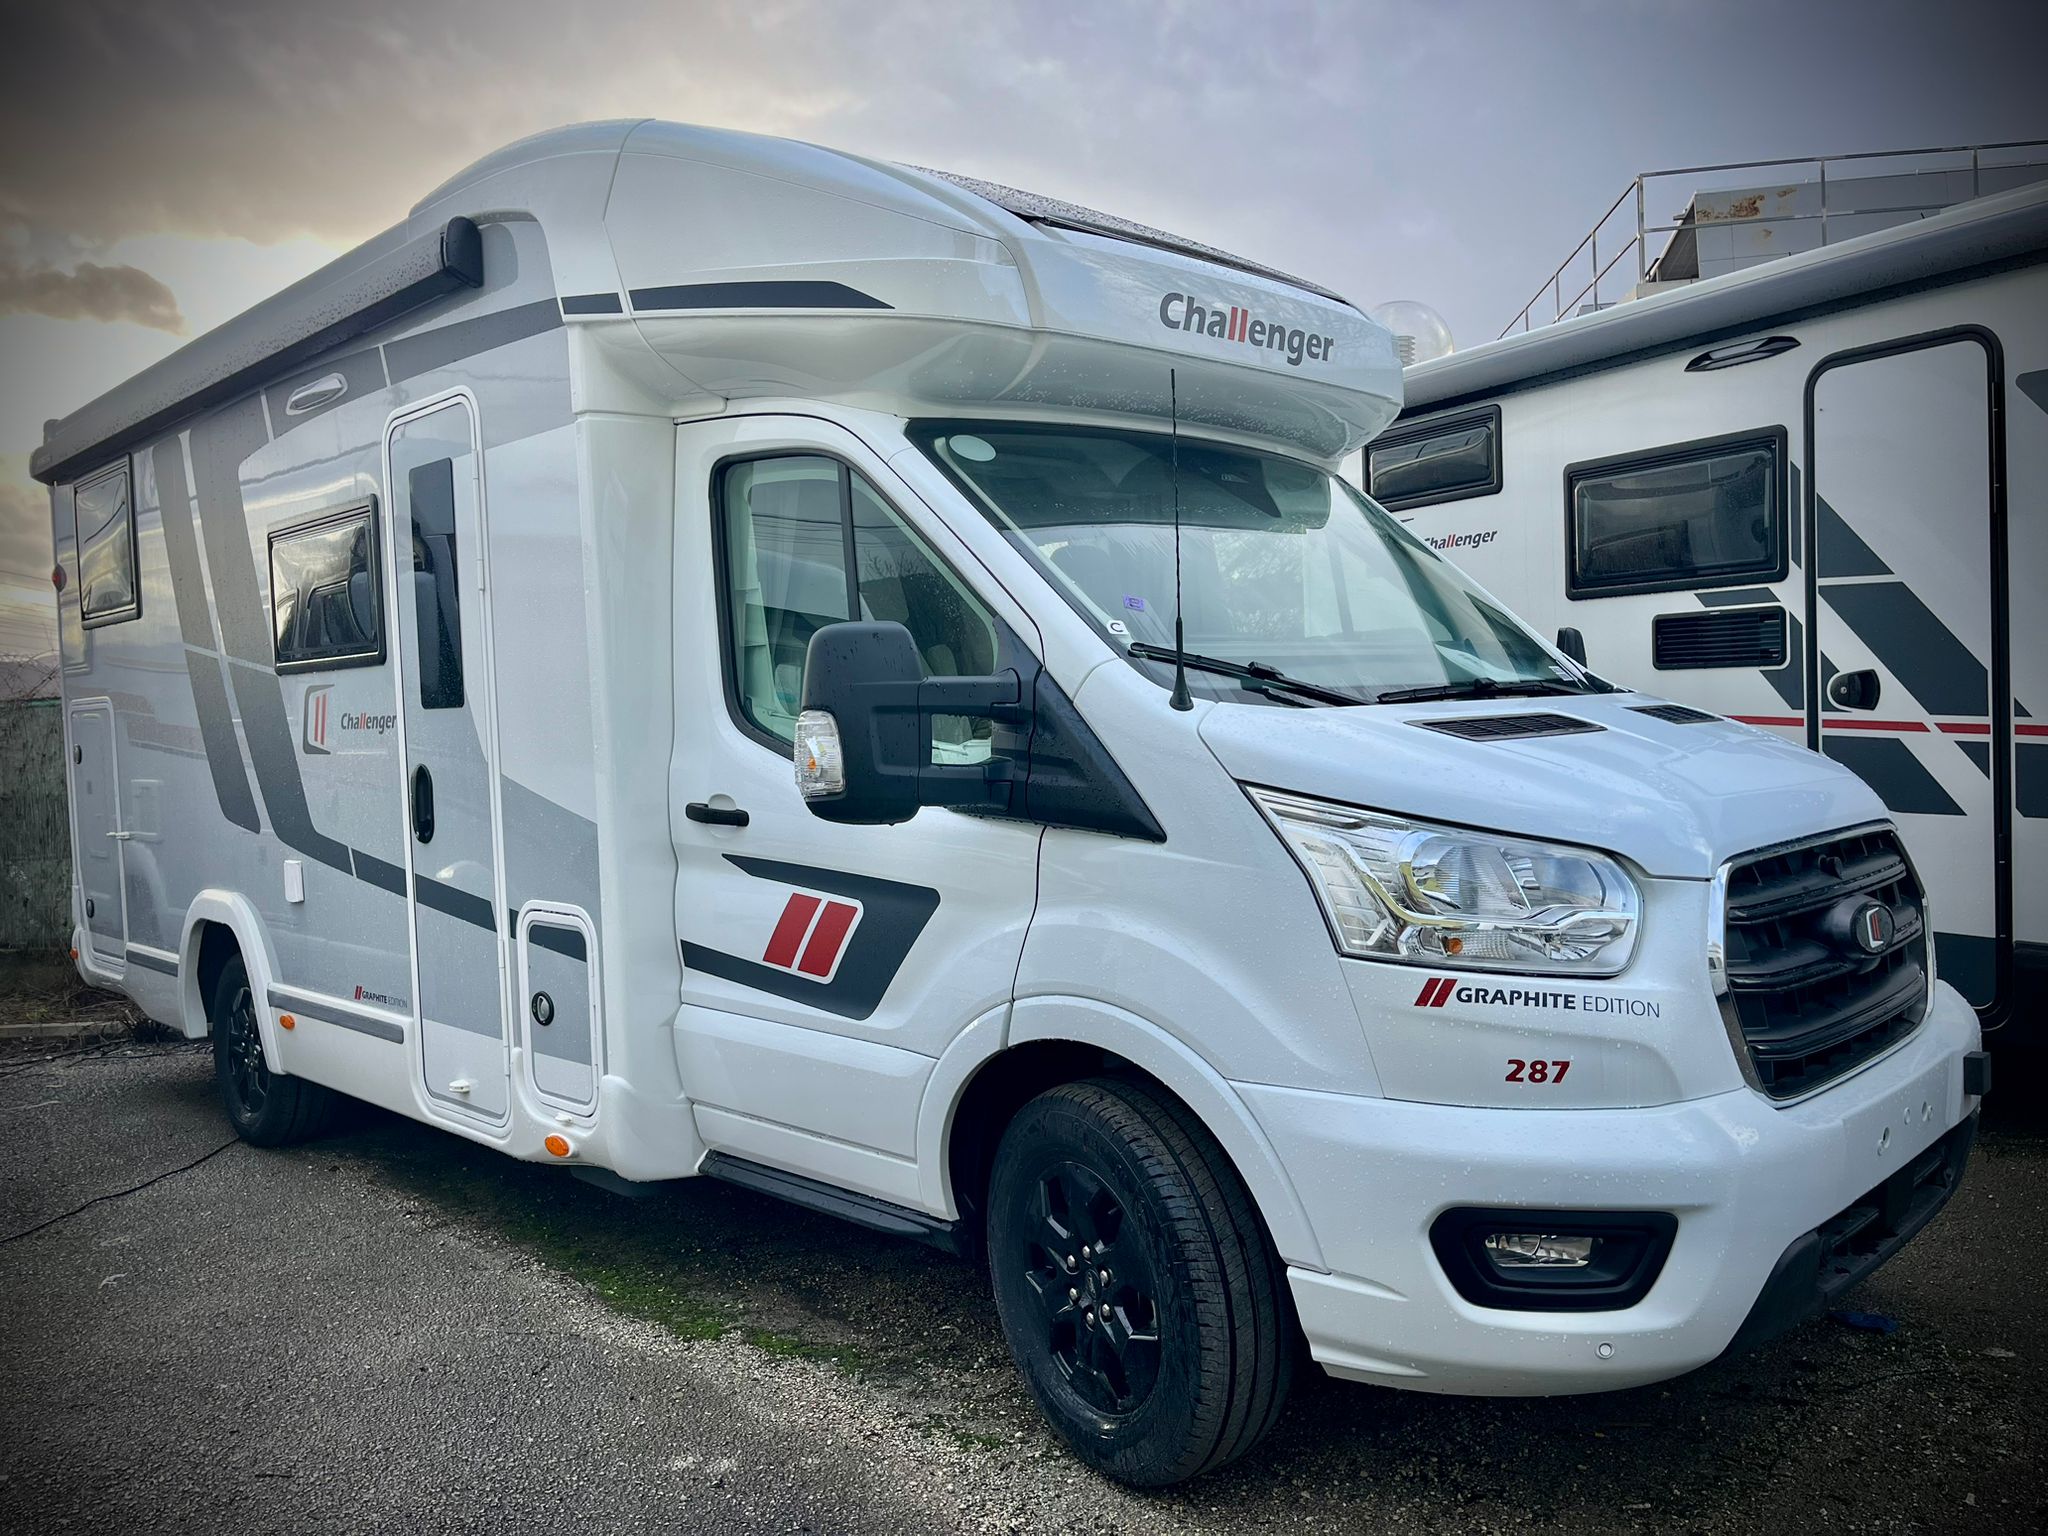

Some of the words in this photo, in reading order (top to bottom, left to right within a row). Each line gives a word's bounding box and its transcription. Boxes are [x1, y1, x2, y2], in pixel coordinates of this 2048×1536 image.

[1159, 292, 1335, 367] Challenger
[340, 712, 397, 735] Challenger
[361, 990, 388, 1004] GRAPHITE
[388, 995, 408, 1009] EDITION
[1455, 986, 1577, 1010] GRAPHITE
[1583, 995, 1660, 1018] EDITION
[1505, 1059, 1571, 1084] 287
